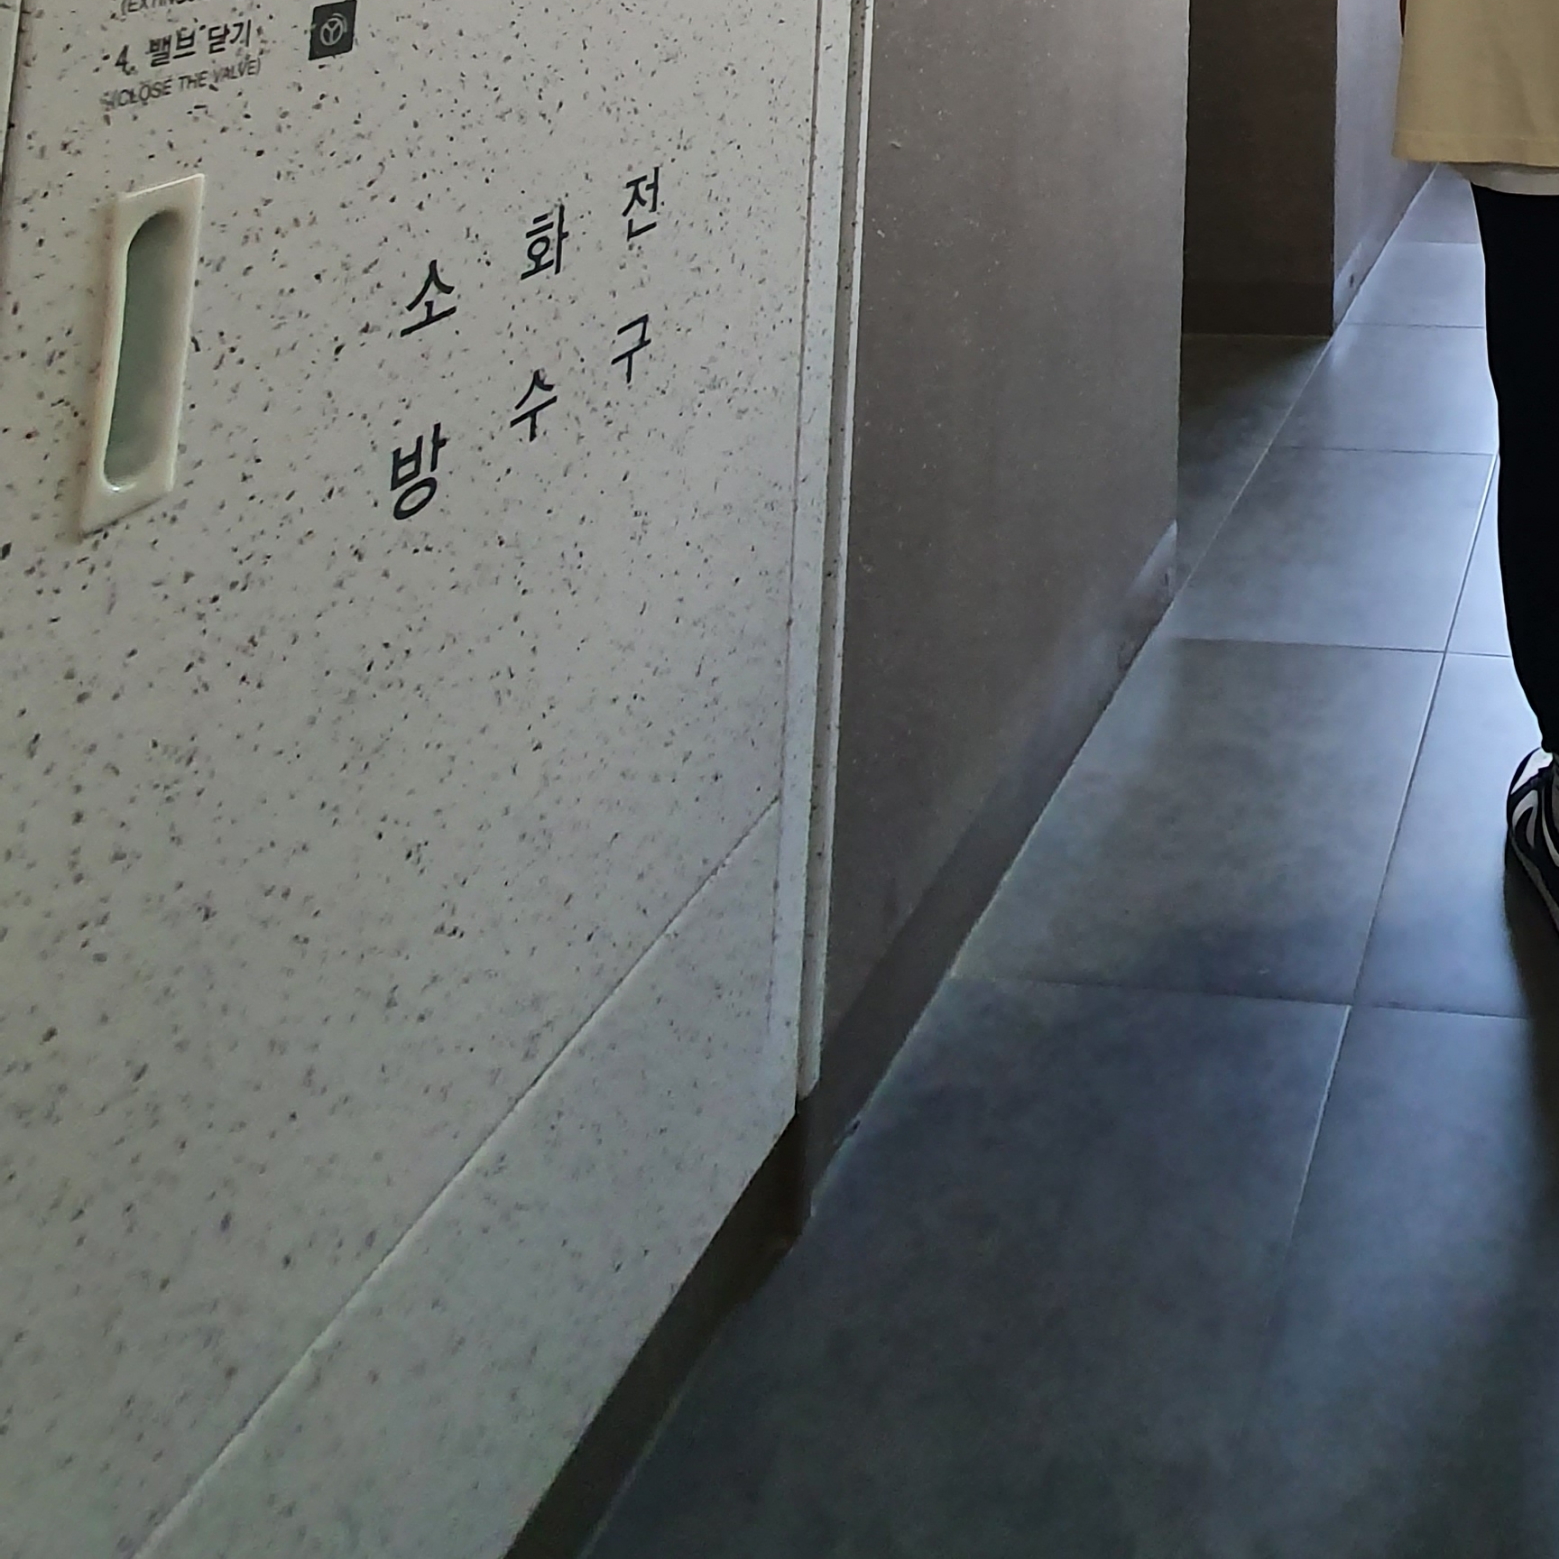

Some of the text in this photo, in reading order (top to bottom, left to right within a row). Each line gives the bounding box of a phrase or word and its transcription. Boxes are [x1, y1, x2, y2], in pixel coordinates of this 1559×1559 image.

[114, 19, 251, 75] 4. 밸브 닫기
[178, 71, 208, 91] THE
[213, 57, 261, 84] VALVE)
